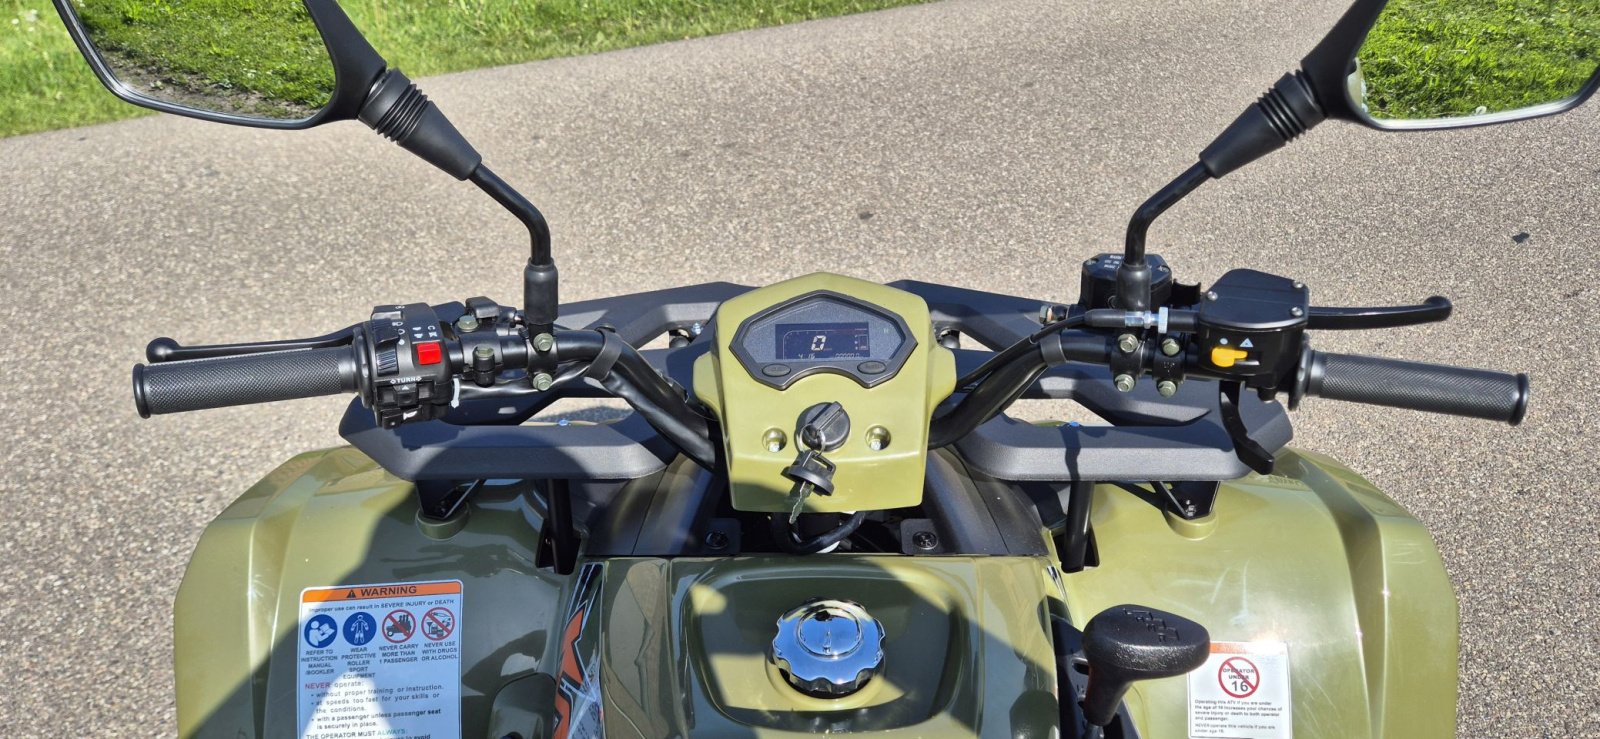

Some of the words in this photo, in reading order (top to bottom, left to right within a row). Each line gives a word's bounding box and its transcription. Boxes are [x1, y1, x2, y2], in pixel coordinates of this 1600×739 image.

[811, 335, 827, 351] 0
[360, 586, 418, 597] WARNING
[381, 601, 405, 609] SEVERE
[383, 656, 418, 664] PASSENGER
[304, 681, 331, 689] NEVER
[1231, 680, 1249, 692] 16
[316, 690, 341, 698] without
[344, 689, 366, 697] proper
[326, 698, 350, 706] speeds
[411, 692, 429, 700] skills
[336, 713, 369, 721] passenger
[393, 709, 426, 718] passenger
[324, 721, 351, 729] securely
[320, 731, 356, 739] OPERATOR
